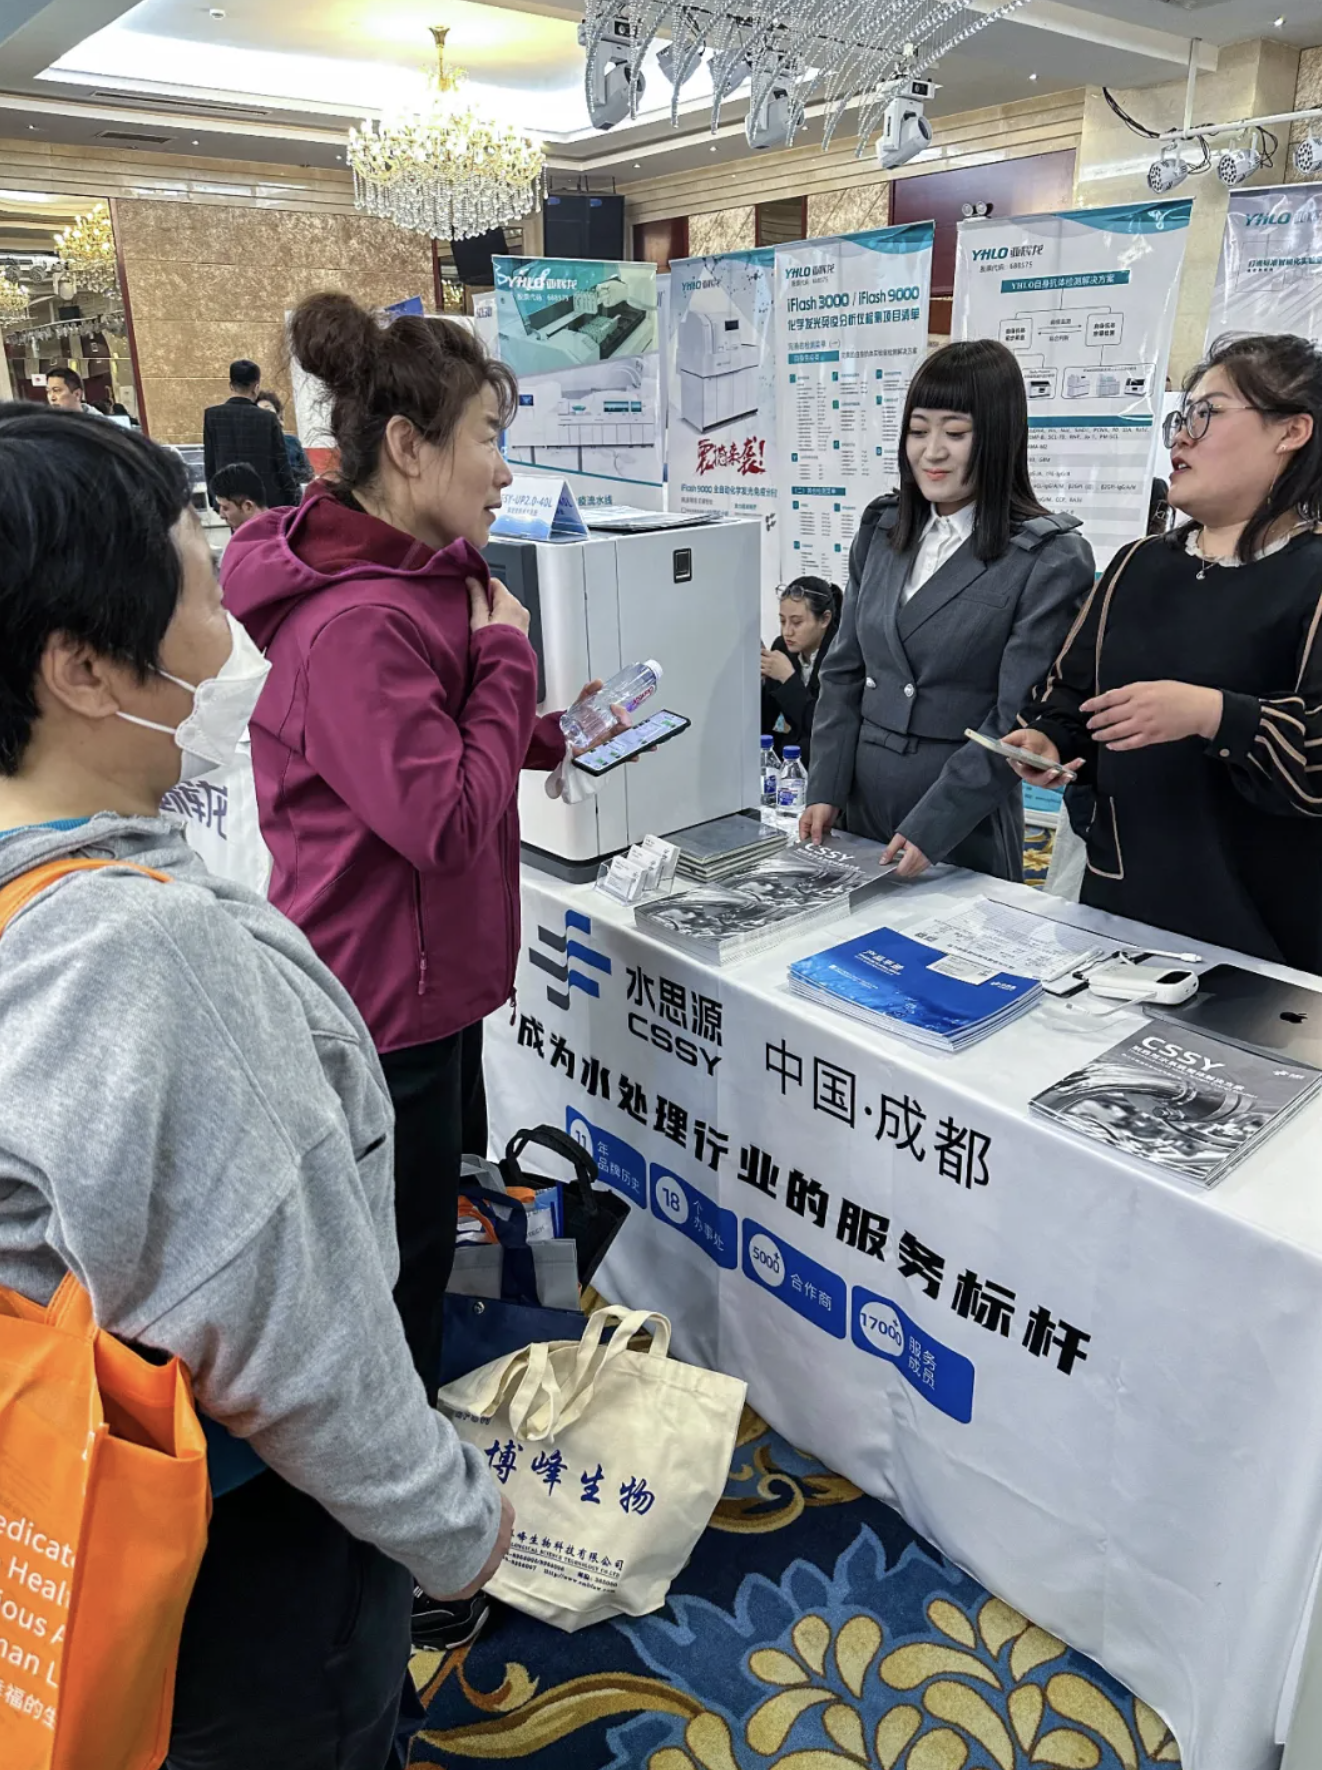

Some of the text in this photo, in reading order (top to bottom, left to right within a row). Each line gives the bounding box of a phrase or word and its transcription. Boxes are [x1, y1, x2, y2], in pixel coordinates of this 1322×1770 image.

[972, 244, 1044, 262] YHLO 亚辉龙
[785, 266, 811, 279] YHLO
[787, 296, 817, 313] iFlash
[818, 293, 849, 310] 3000
[858, 289, 886, 306] iFlash
[887, 286, 920, 302] 9000
[787, 307, 920, 331] 化学发光免疫分析仪检测项目清单
[577, 495, 613, 506] 疫流水线
[626, 966, 723, 1047] 水思源
[628, 1012, 722, 1077] CSSY
[1142, 1036, 1226, 1072] CSSY
[597, 1141, 609, 1157] 年
[598, 1157, 641, 1194] 品牌历史
[517, 1013, 1091, 1375] 成为水处理行业的服务标杆
[662, 1187, 681, 1212] 18
[693, 1216, 725, 1252] 办事处
[790, 1272, 832, 1312] 合作商
[908, 1336, 938, 1372] 服务
[908, 1358, 936, 1391] 成员
[484, 1439, 656, 1516] 博峰生物
[511, 1529, 624, 1571] 峰生物科技有限公司
[46, 1660, 59, 1689] L
